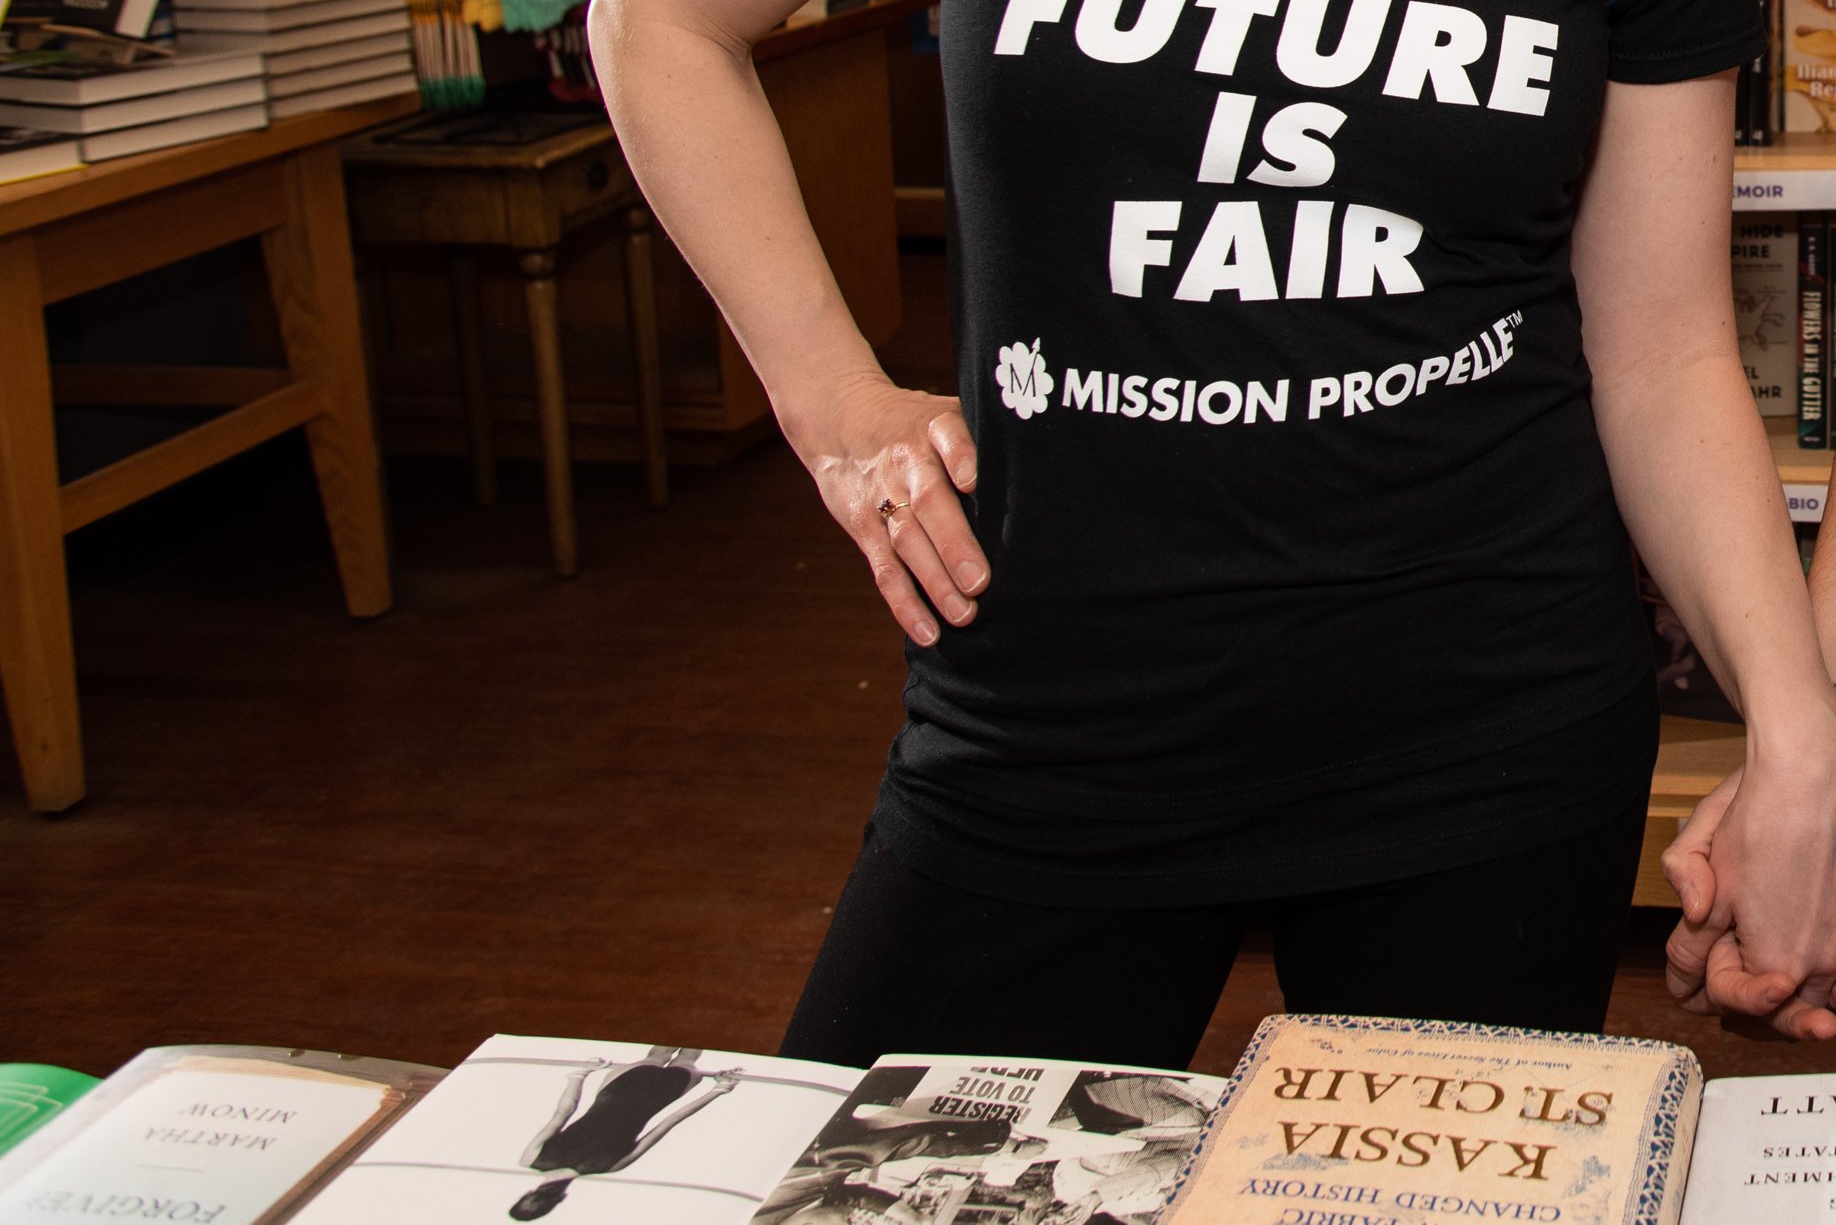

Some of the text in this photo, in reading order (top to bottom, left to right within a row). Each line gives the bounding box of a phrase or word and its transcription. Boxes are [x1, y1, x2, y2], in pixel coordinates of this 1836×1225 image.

[1197, 92, 1348, 187] IS
[1109, 200, 1425, 302] FAIR
[1741, 225, 1784, 238] HIDE
[1803, 291, 1822, 420] FLOWERS IN THE GUTTER
[1062, 368, 1290, 424] MISSION
[1788, 497, 1819, 510] BIO
[929, 1094, 1032, 1123] REGISTER
[952, 1076, 1035, 1103] TO VOTE
[1274, 1066, 1614, 1127] ST. CLAIR
[179, 1103, 297, 1123] MINOW
[145, 1126, 277, 1150] MARTHA
[1277, 1120, 1558, 1181] KASSIA
[1239, 1178, 1562, 1224] CHANGED HISTORY
